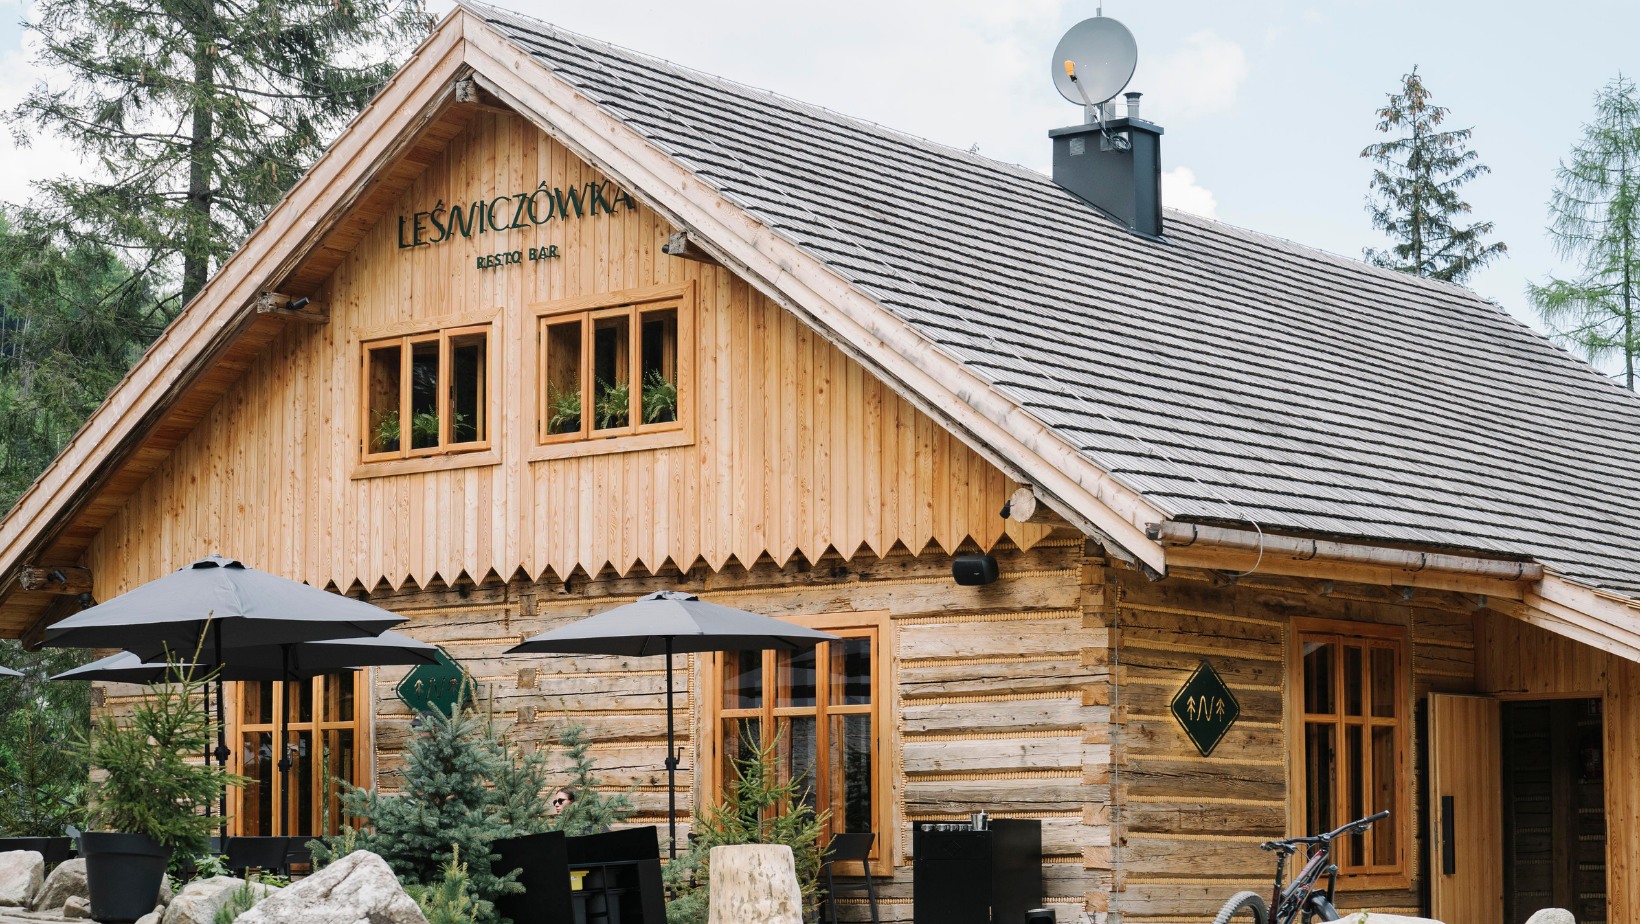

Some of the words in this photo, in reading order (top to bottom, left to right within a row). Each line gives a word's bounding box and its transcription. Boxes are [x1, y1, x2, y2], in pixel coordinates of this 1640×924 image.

[399, 180, 635, 249] LEŚNICZÓWKA
[477, 251, 521, 269] RESTO
[529, 245, 559, 262] BAR
